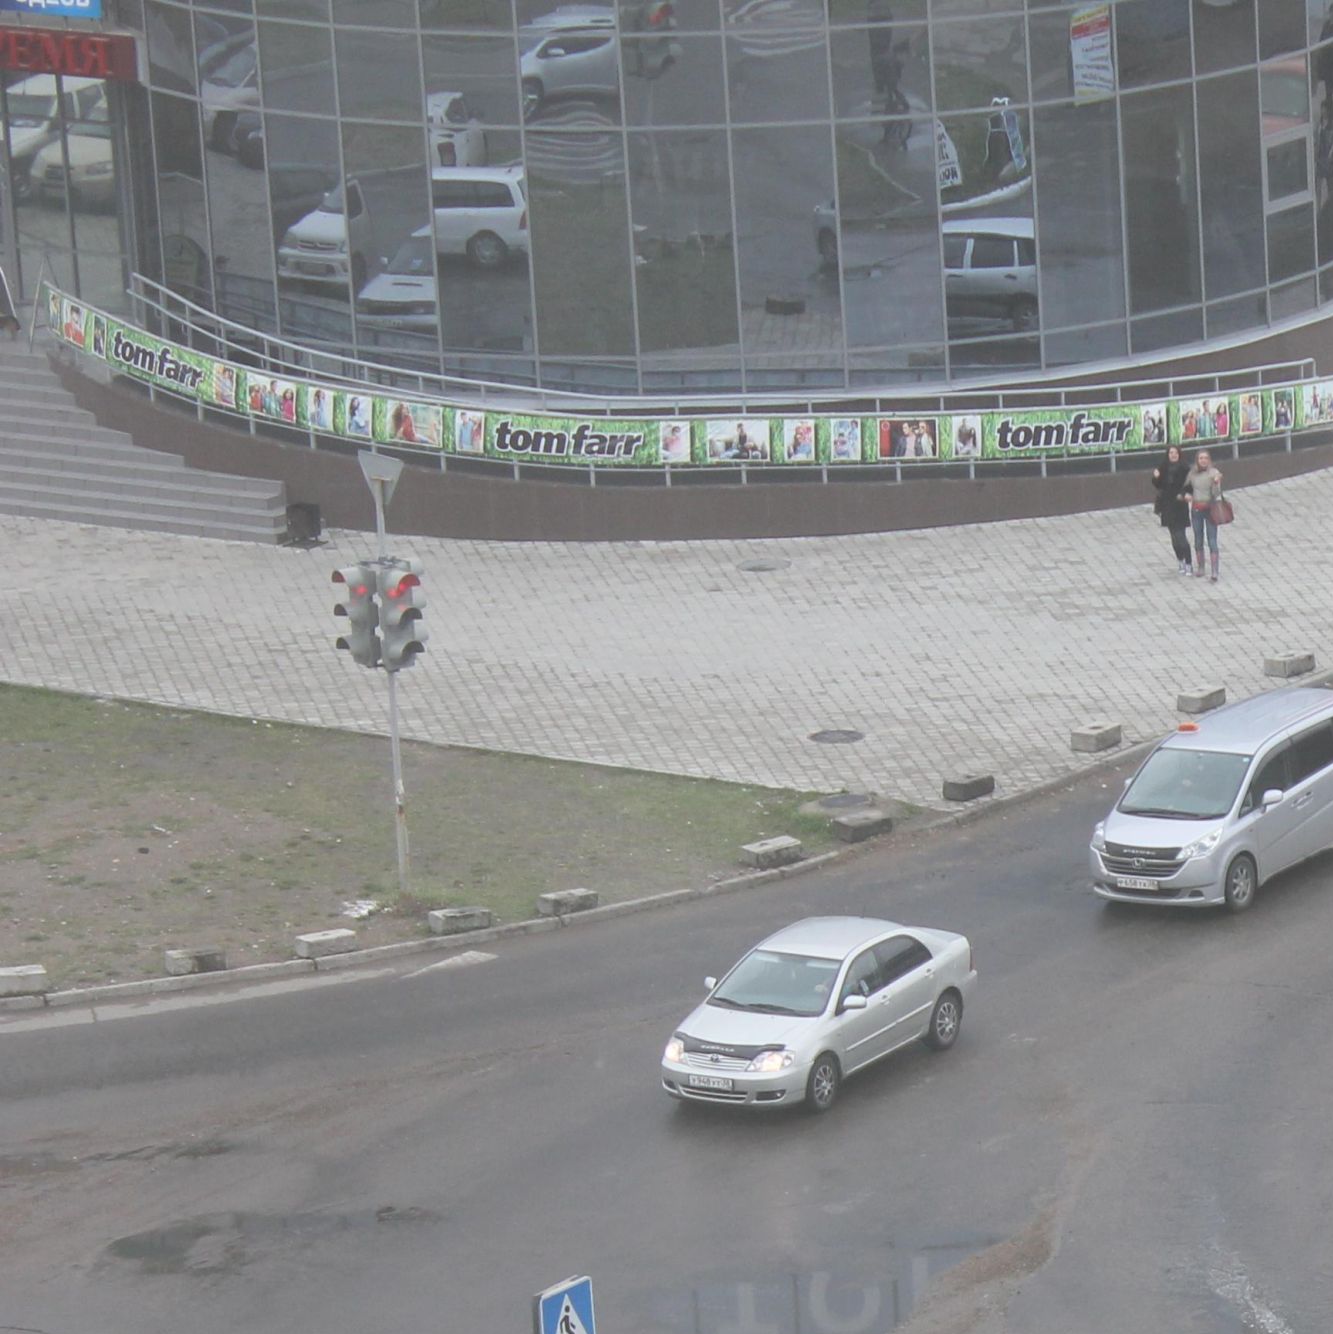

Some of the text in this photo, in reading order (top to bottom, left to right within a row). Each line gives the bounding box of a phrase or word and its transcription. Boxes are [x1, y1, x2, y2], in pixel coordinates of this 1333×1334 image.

[112, 329, 204, 390] tom farr
[495, 420, 643, 456] tom farr
[996, 412, 1133, 450] tom farr
